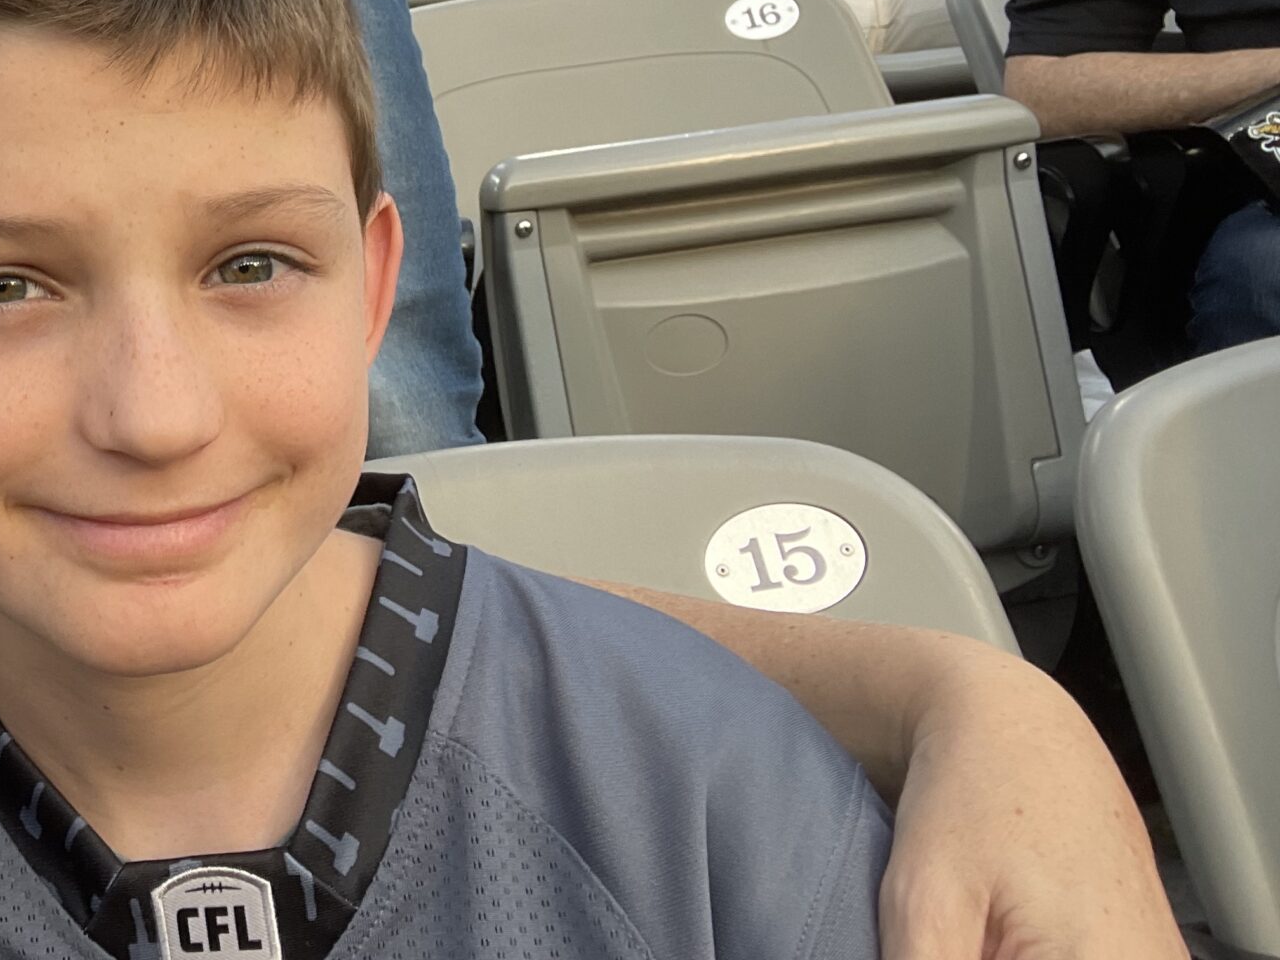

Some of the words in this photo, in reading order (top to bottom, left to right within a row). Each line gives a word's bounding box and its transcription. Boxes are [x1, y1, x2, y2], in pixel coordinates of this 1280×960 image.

[741, 1, 782, 31] 16
[737, 525, 828, 594] 15
[176, 905, 263, 953] CFL
